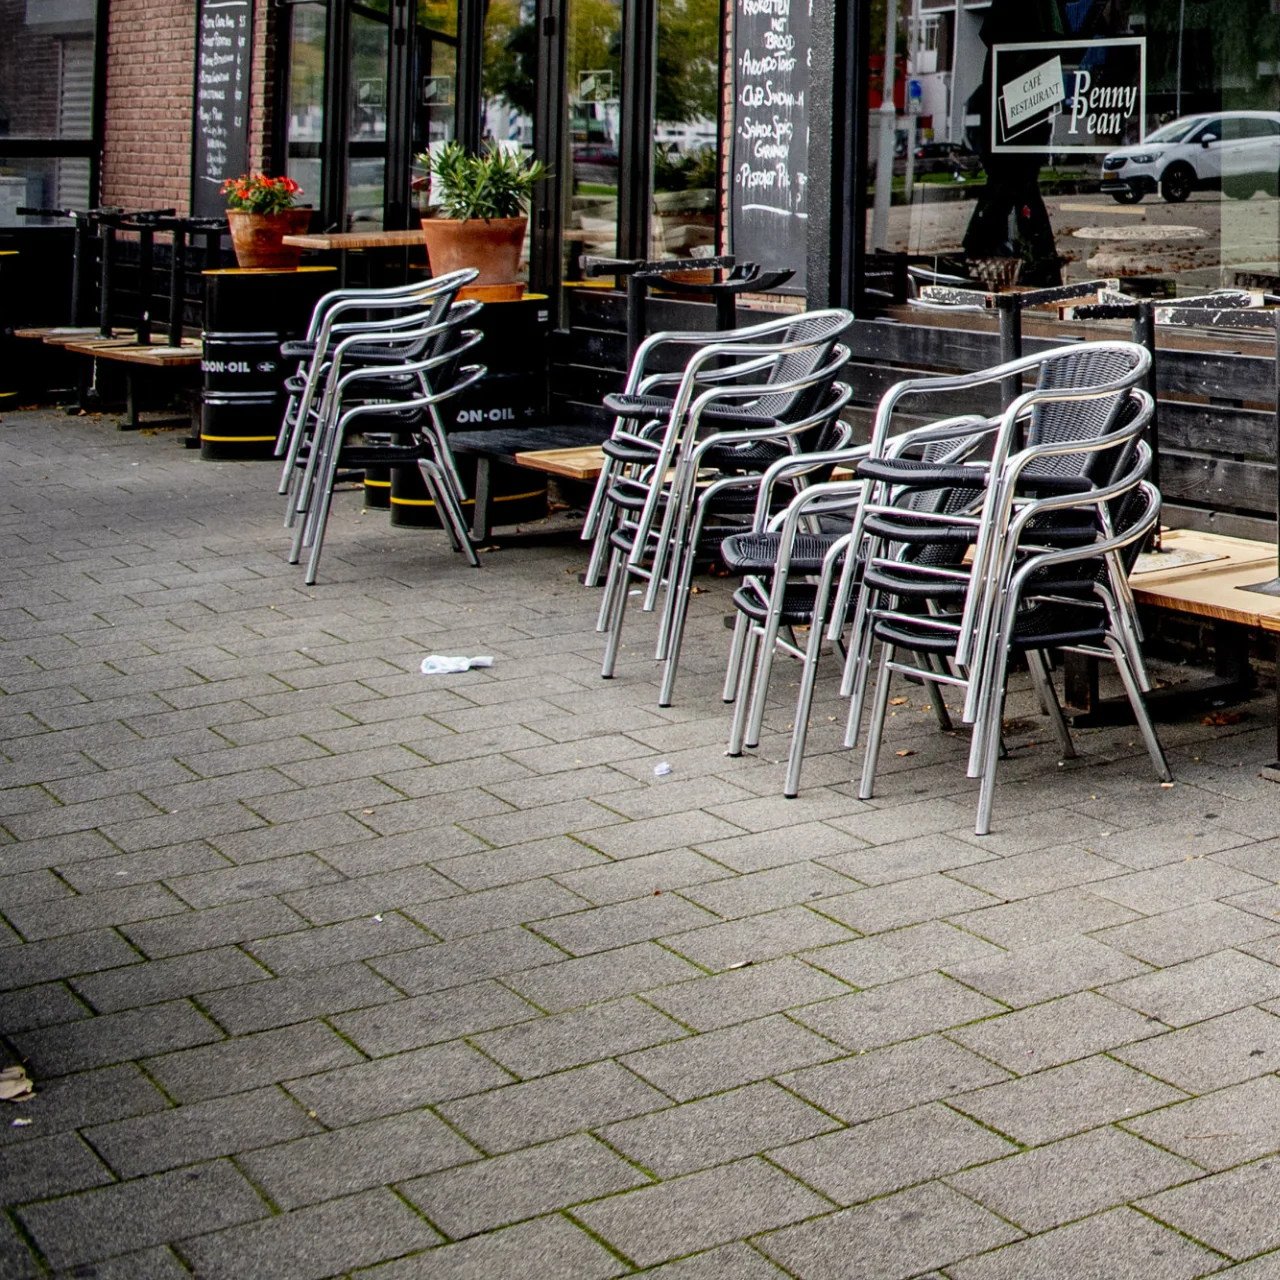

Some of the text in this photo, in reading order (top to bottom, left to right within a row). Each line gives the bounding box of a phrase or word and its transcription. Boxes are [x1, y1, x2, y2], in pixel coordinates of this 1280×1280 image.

[764, 31, 796, 51] BROOD
[743, 48, 778, 76] AVOCADO
[1022, 71, 1043, 94] CAFÉ
[1071, 70, 1137, 119] Penny
[1010, 82, 1060, 118] RESTAURANT
[1068, 96, 1122, 135] Pean
